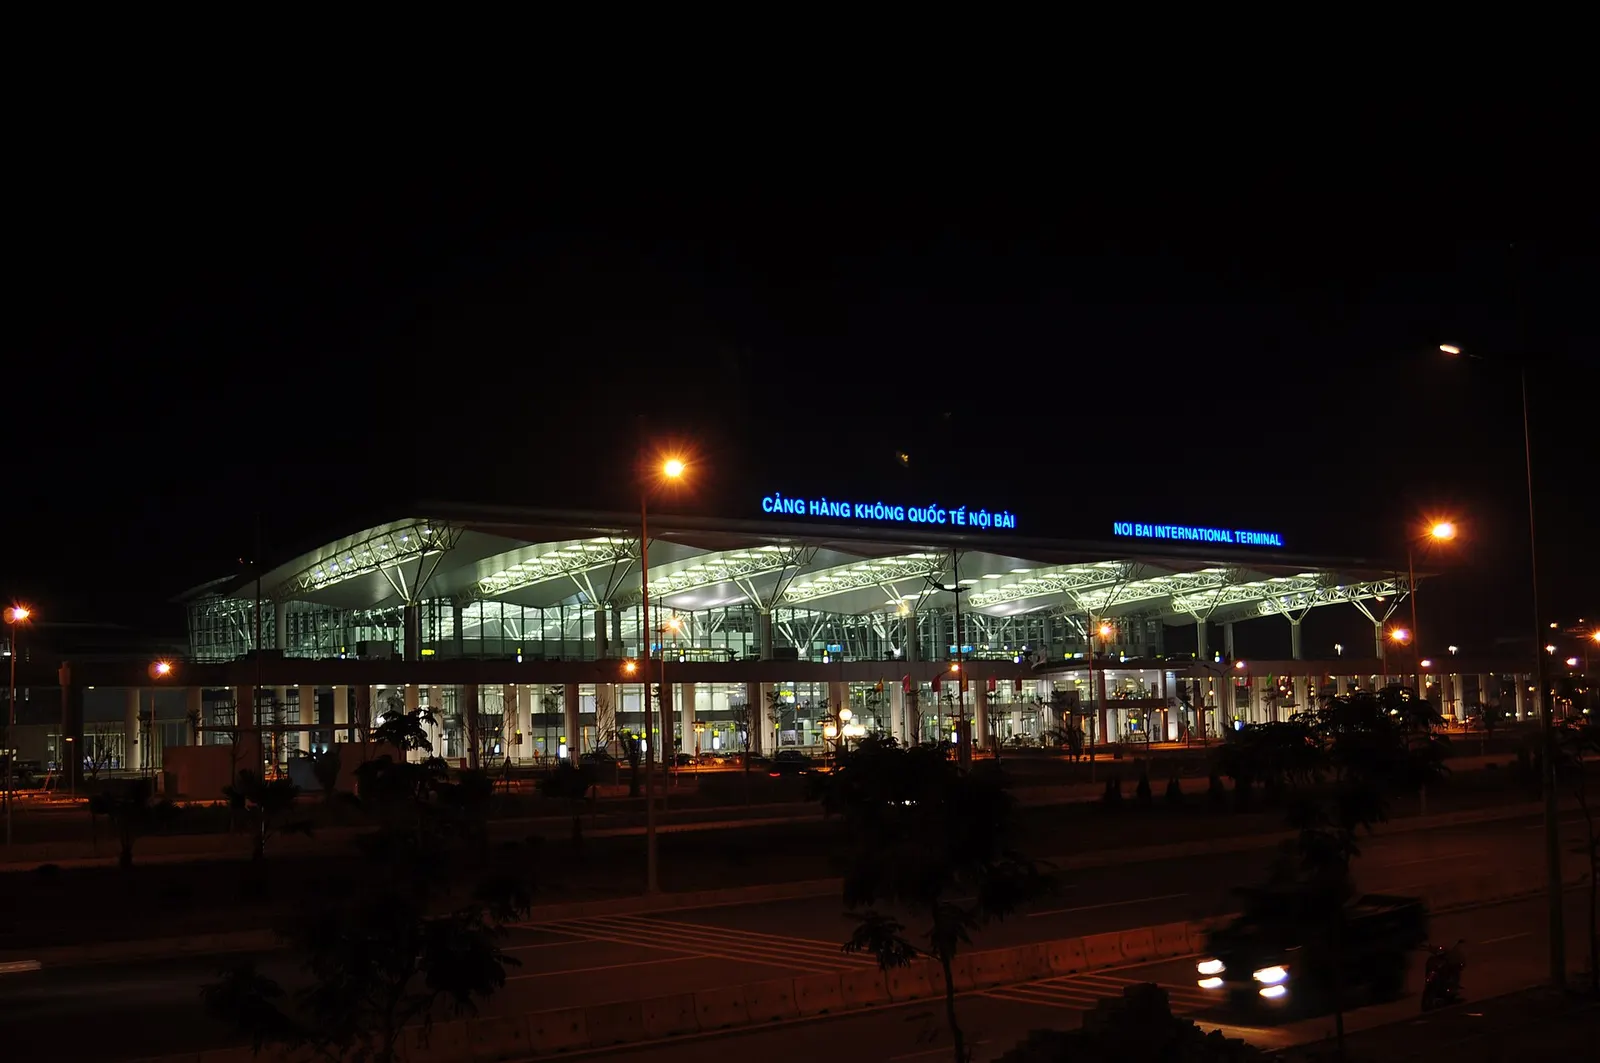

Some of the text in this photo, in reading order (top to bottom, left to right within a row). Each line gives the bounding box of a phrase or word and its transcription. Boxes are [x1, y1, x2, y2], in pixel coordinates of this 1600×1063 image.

[762, 492, 1015, 530] CẢNG HÀNG KHÔNG QUỐC TẾ NỘI BÀI
[1113, 522, 1282, 547] NOI BAI INTERNATIONAL TERMINAL
